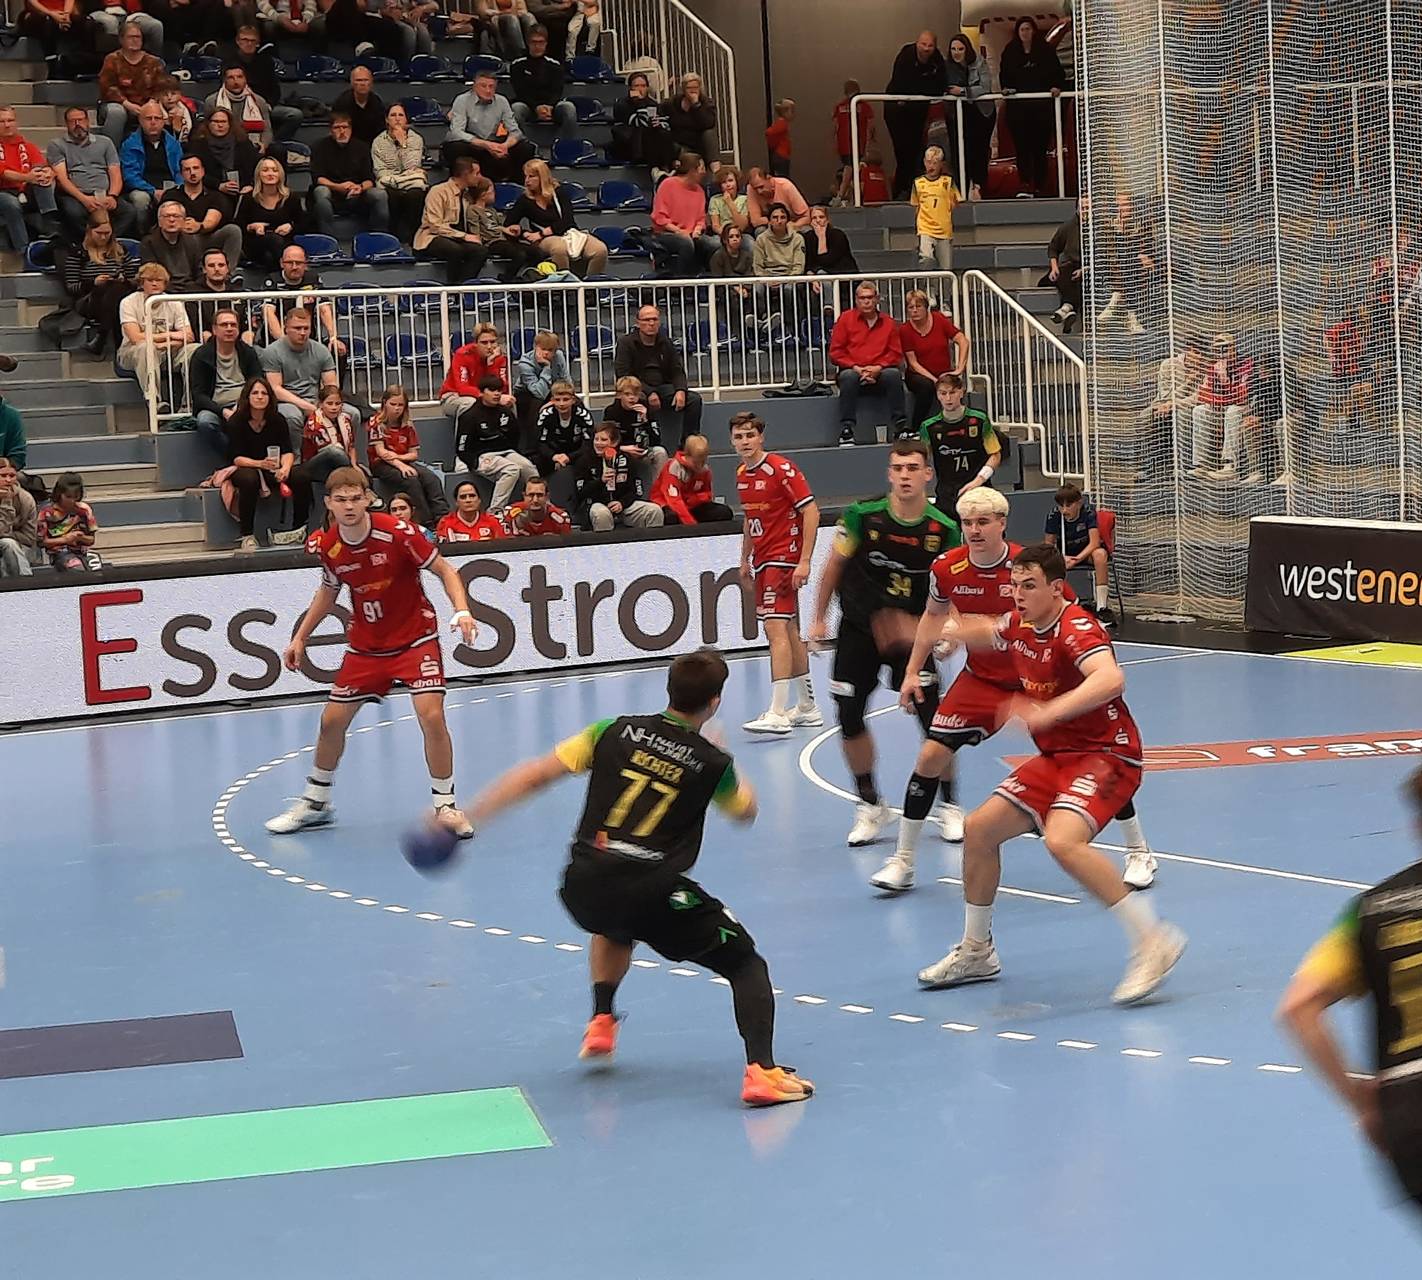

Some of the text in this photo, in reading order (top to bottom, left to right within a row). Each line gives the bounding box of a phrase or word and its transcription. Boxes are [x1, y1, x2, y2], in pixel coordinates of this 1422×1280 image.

[953, 456, 969, 472] 74
[748, 518, 763, 537] 20
[363, 600, 383, 624] 91
[79, 588, 356, 706] Esse
[604, 768, 680, 837] 77
